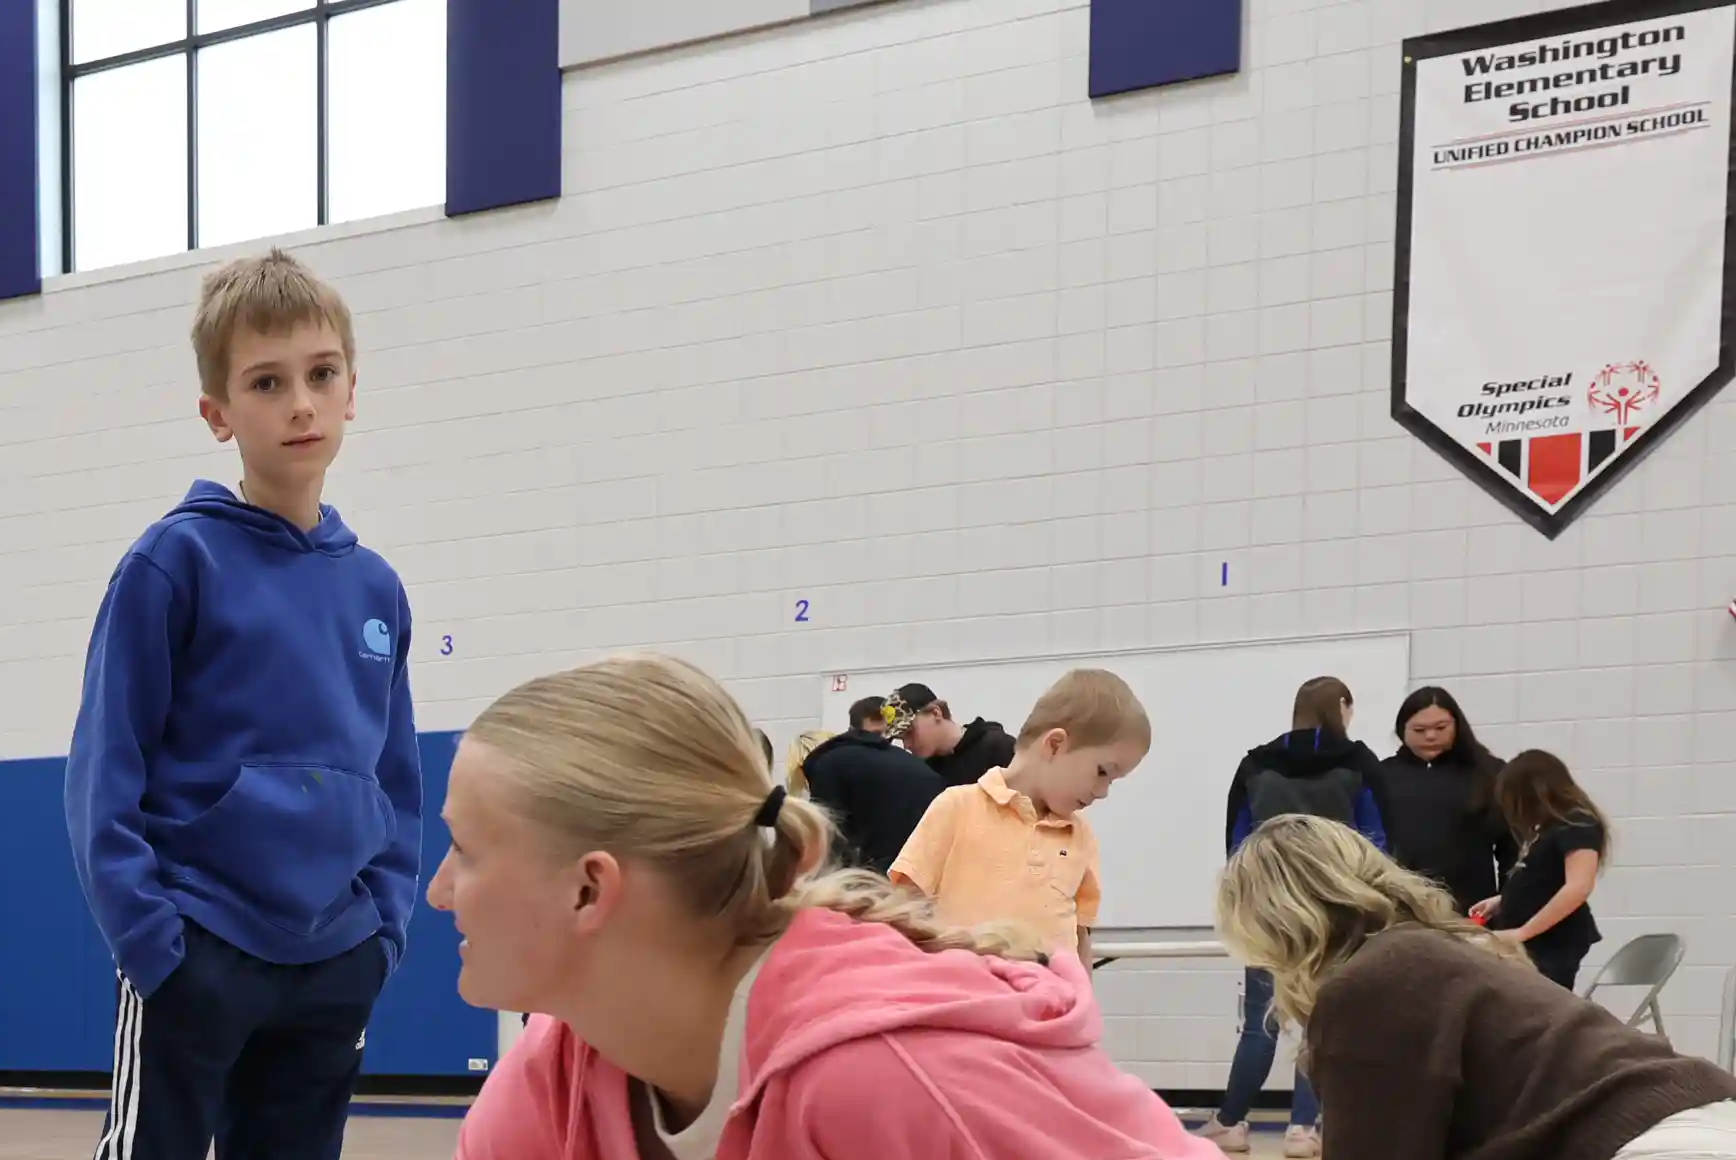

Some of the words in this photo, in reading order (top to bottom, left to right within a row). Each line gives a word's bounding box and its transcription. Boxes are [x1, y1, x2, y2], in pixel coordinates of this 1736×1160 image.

[1461, 25, 1685, 77] Washington
[1463, 54, 1682, 103] Elementary
[1508, 85, 1630, 123] School
[1432, 141, 1509, 165] UNIFIED
[1513, 123, 1622, 153] CHAMPION
[1626, 107, 1709, 135] SCHOOL
[1480, 371, 1572, 398] Special
[1456, 395, 1572, 419] Olympics
[1484, 416, 1570, 435] Minnesota
[795, 599, 810, 622] 2
[440, 635, 454, 656] 3
